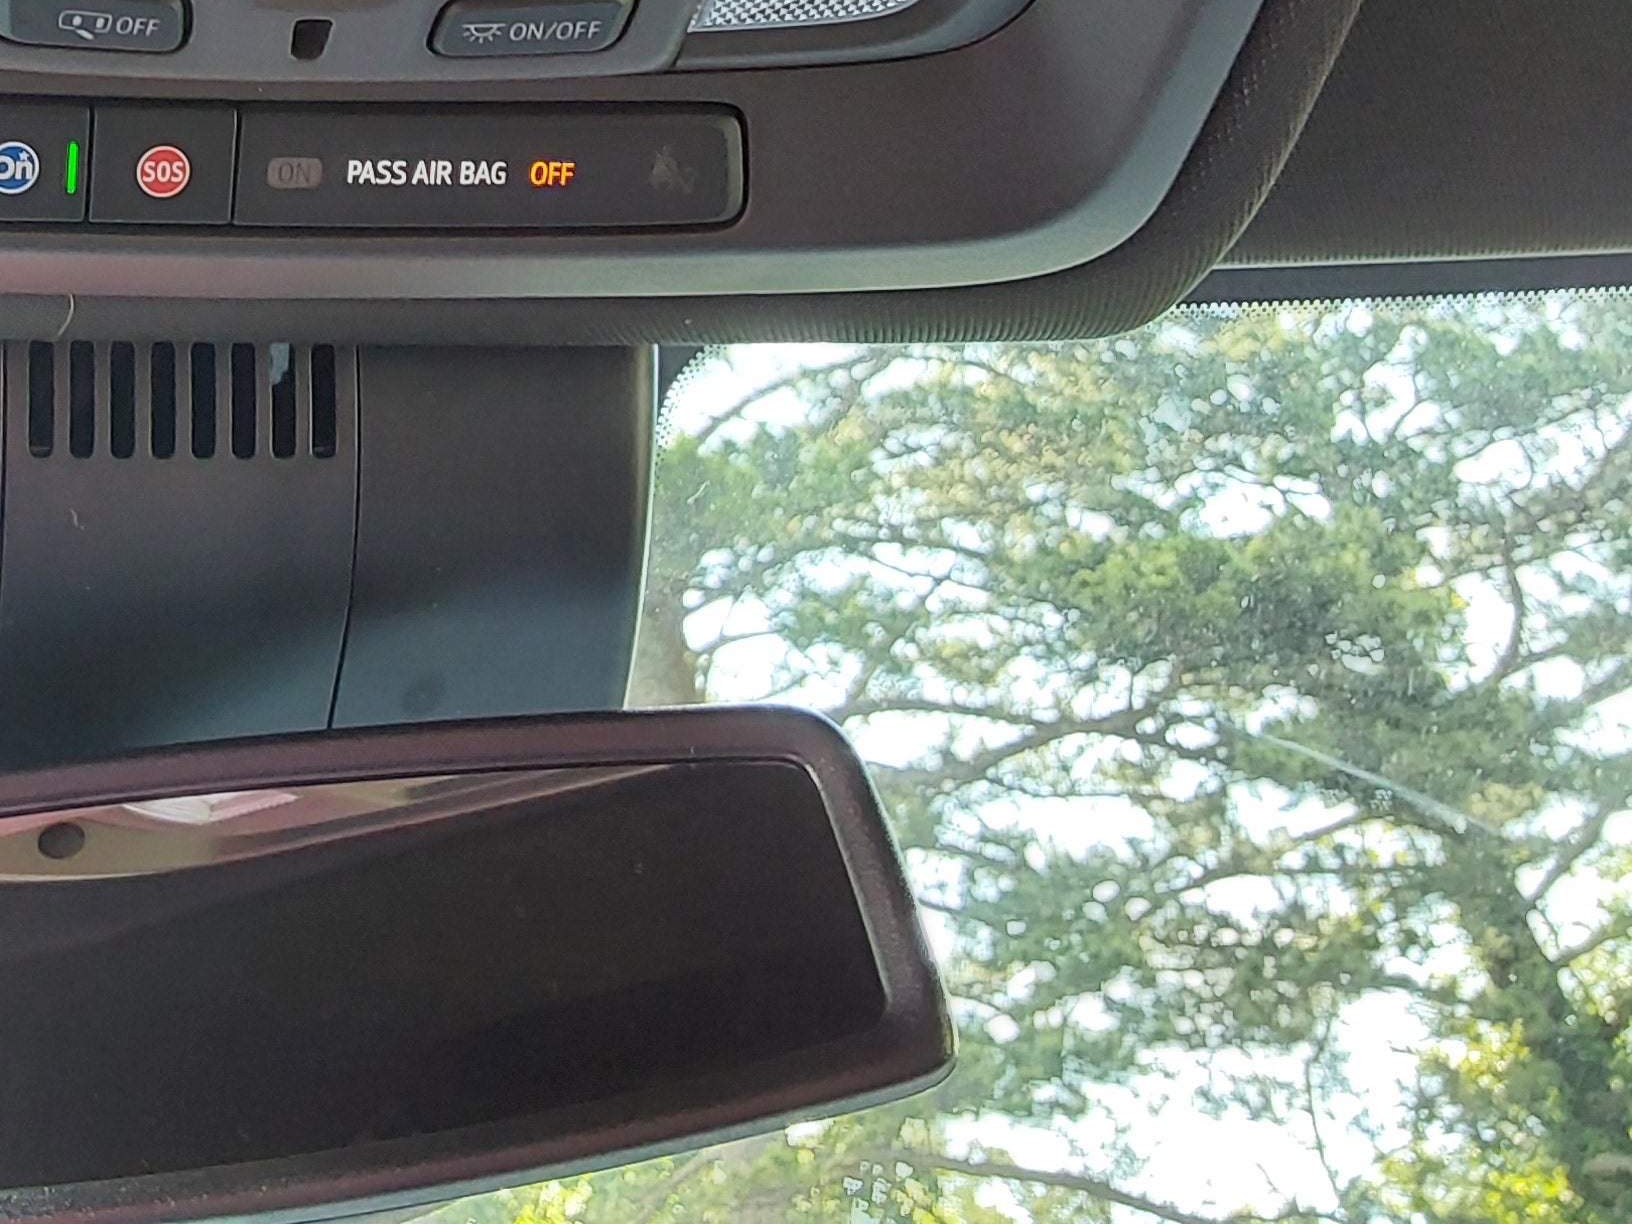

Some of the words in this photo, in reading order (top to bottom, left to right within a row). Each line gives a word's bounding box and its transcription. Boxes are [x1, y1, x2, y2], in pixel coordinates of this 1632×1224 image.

[116, 16, 160, 36] OFF
[509, 19, 603, 42] ON/OFF
[141, 159, 185, 184] SOS
[277, 162, 311, 184] ON
[346, 160, 407, 185] PASS
[411, 160, 453, 185] AIR
[458, 160, 507, 186] BAG
[529, 161, 575, 187] OFF
